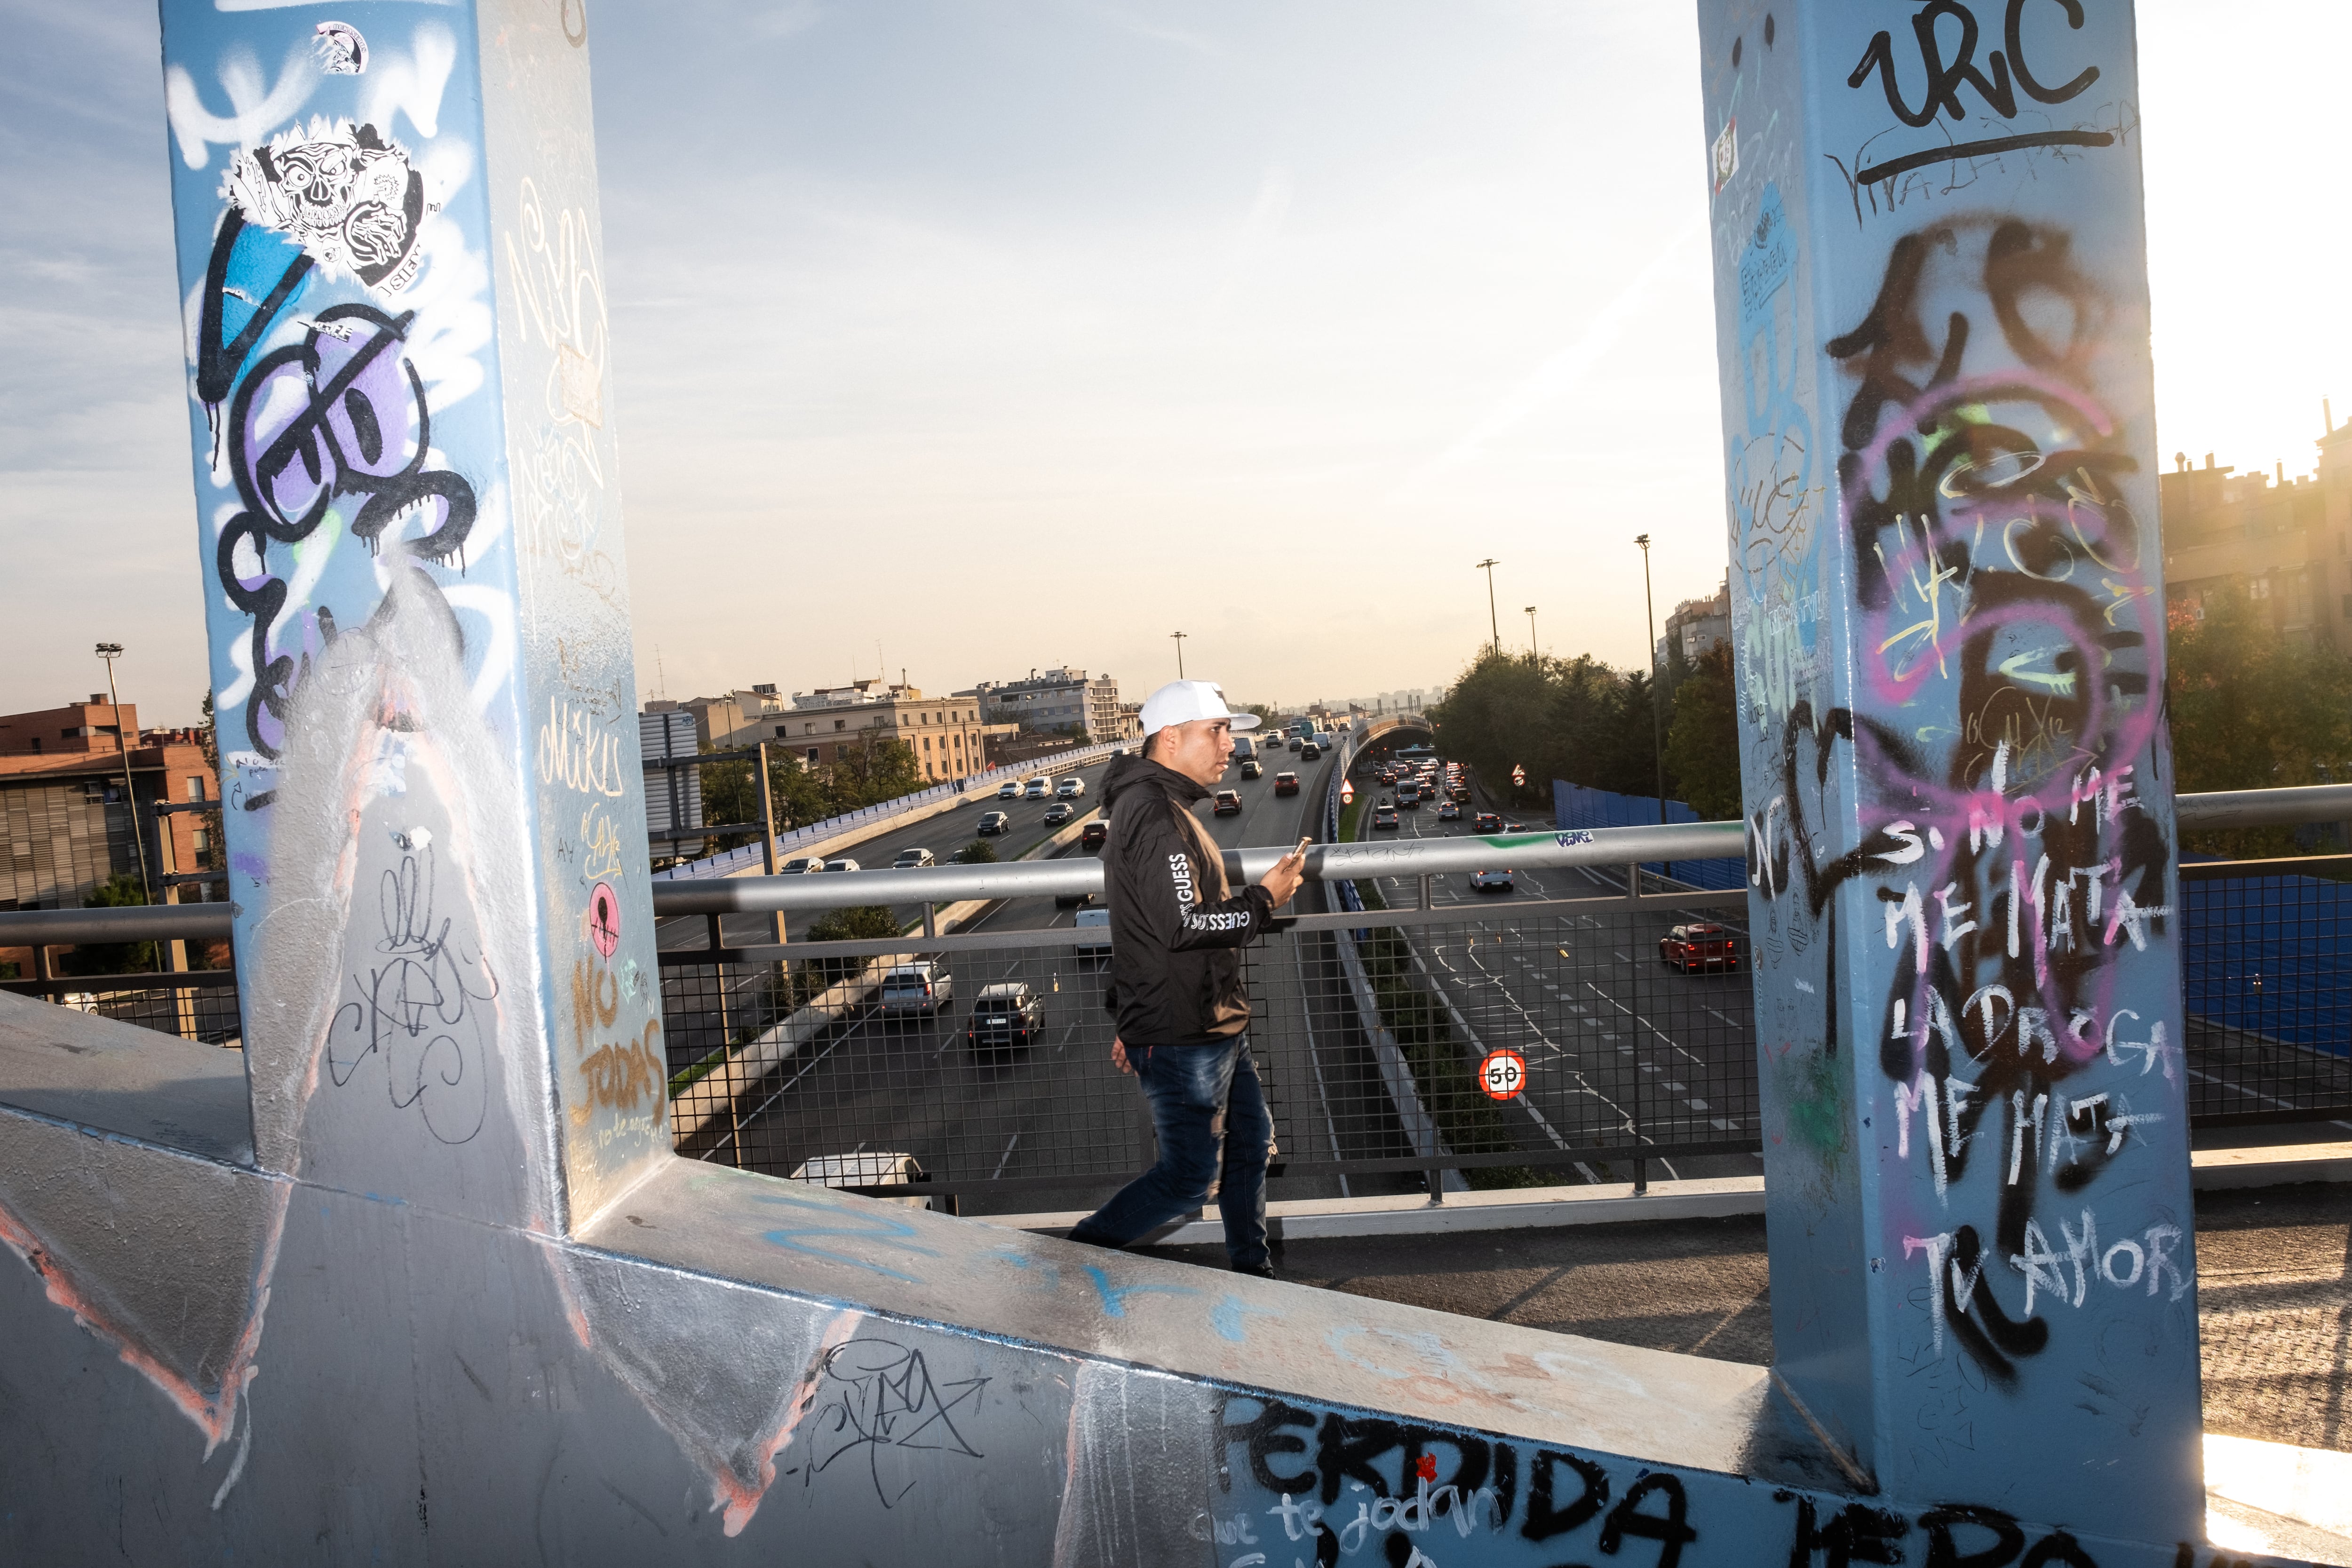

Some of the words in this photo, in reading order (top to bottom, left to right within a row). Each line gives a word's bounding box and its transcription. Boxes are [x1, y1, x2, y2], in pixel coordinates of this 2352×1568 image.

[1168, 853, 1194, 902] GUESS
[1208, 911, 1250, 931] GUESS
[1884, 881, 1978, 975] ME
[2007, 853, 2176, 991] MATA
[1490, 1067, 1517, 1084] 50
[1962, 983, 2183, 1091] DROGA
[2010, 1205, 2196, 1317] AMOR
[1214, 1393, 1697, 1568] PERDIDA
[1266, 1493, 1324, 1541] te
[1339, 1476, 1504, 1554] jodan
